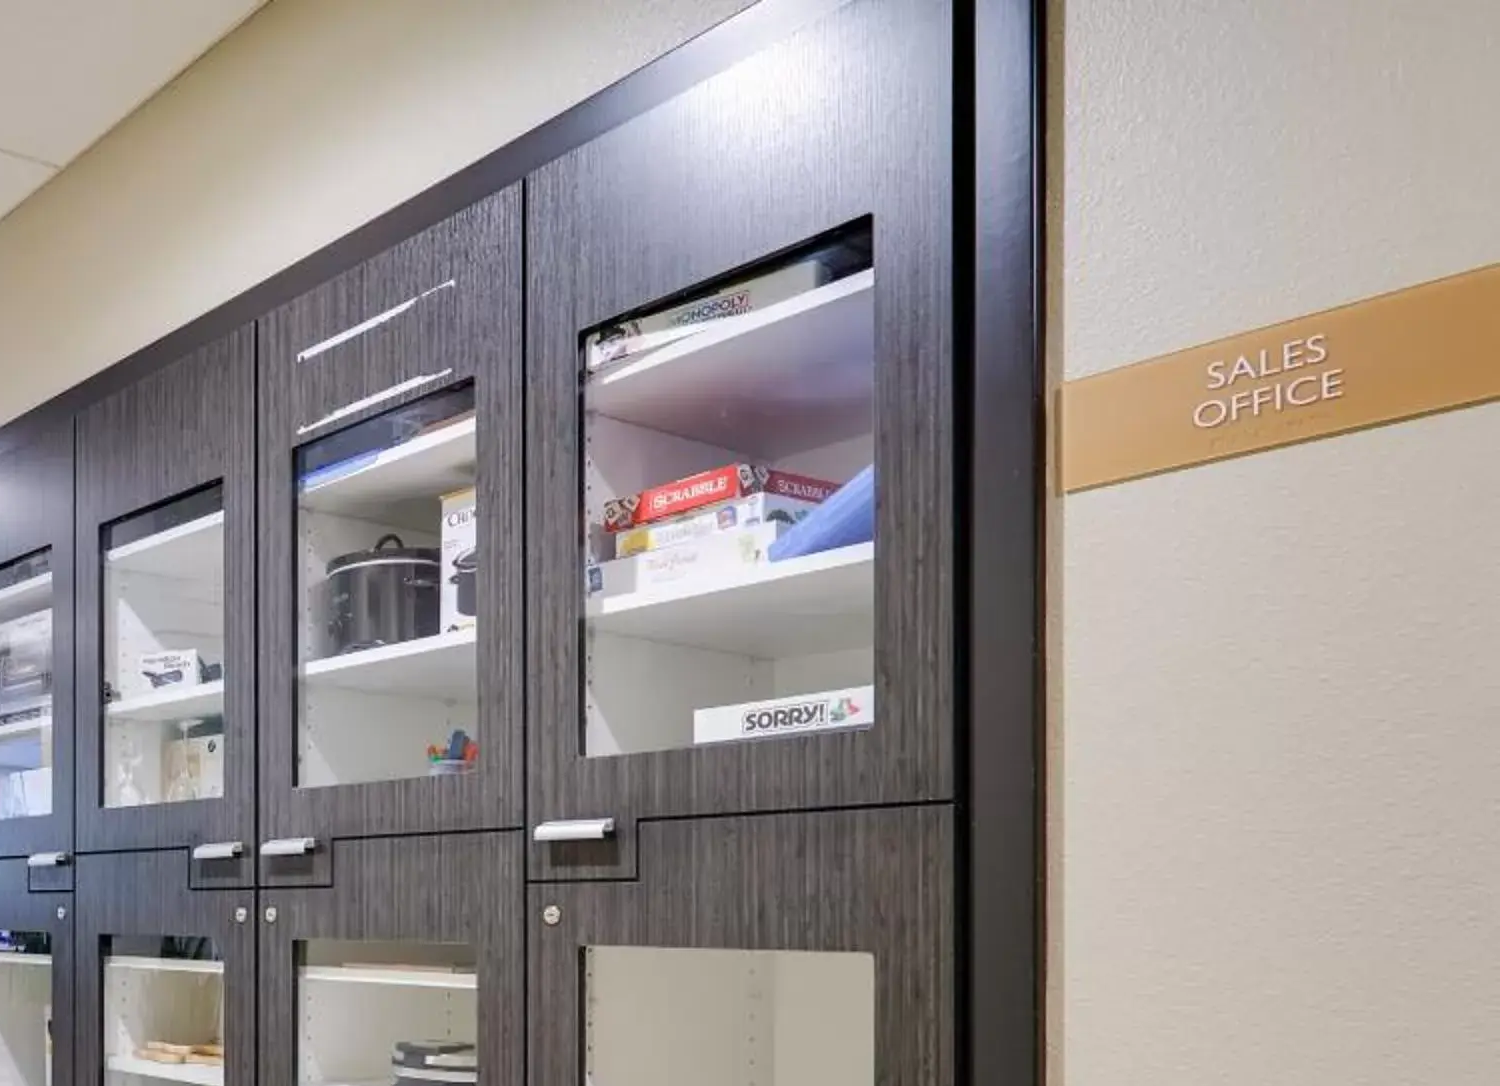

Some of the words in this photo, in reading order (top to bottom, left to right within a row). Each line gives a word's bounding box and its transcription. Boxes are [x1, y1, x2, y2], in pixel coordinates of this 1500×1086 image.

[1206, 334, 1328, 390] SALES
[1192, 367, 1346, 430] OFFICE
[652, 476, 728, 510] SCRABBLE
[744, 703, 826, 732] SORRY!
